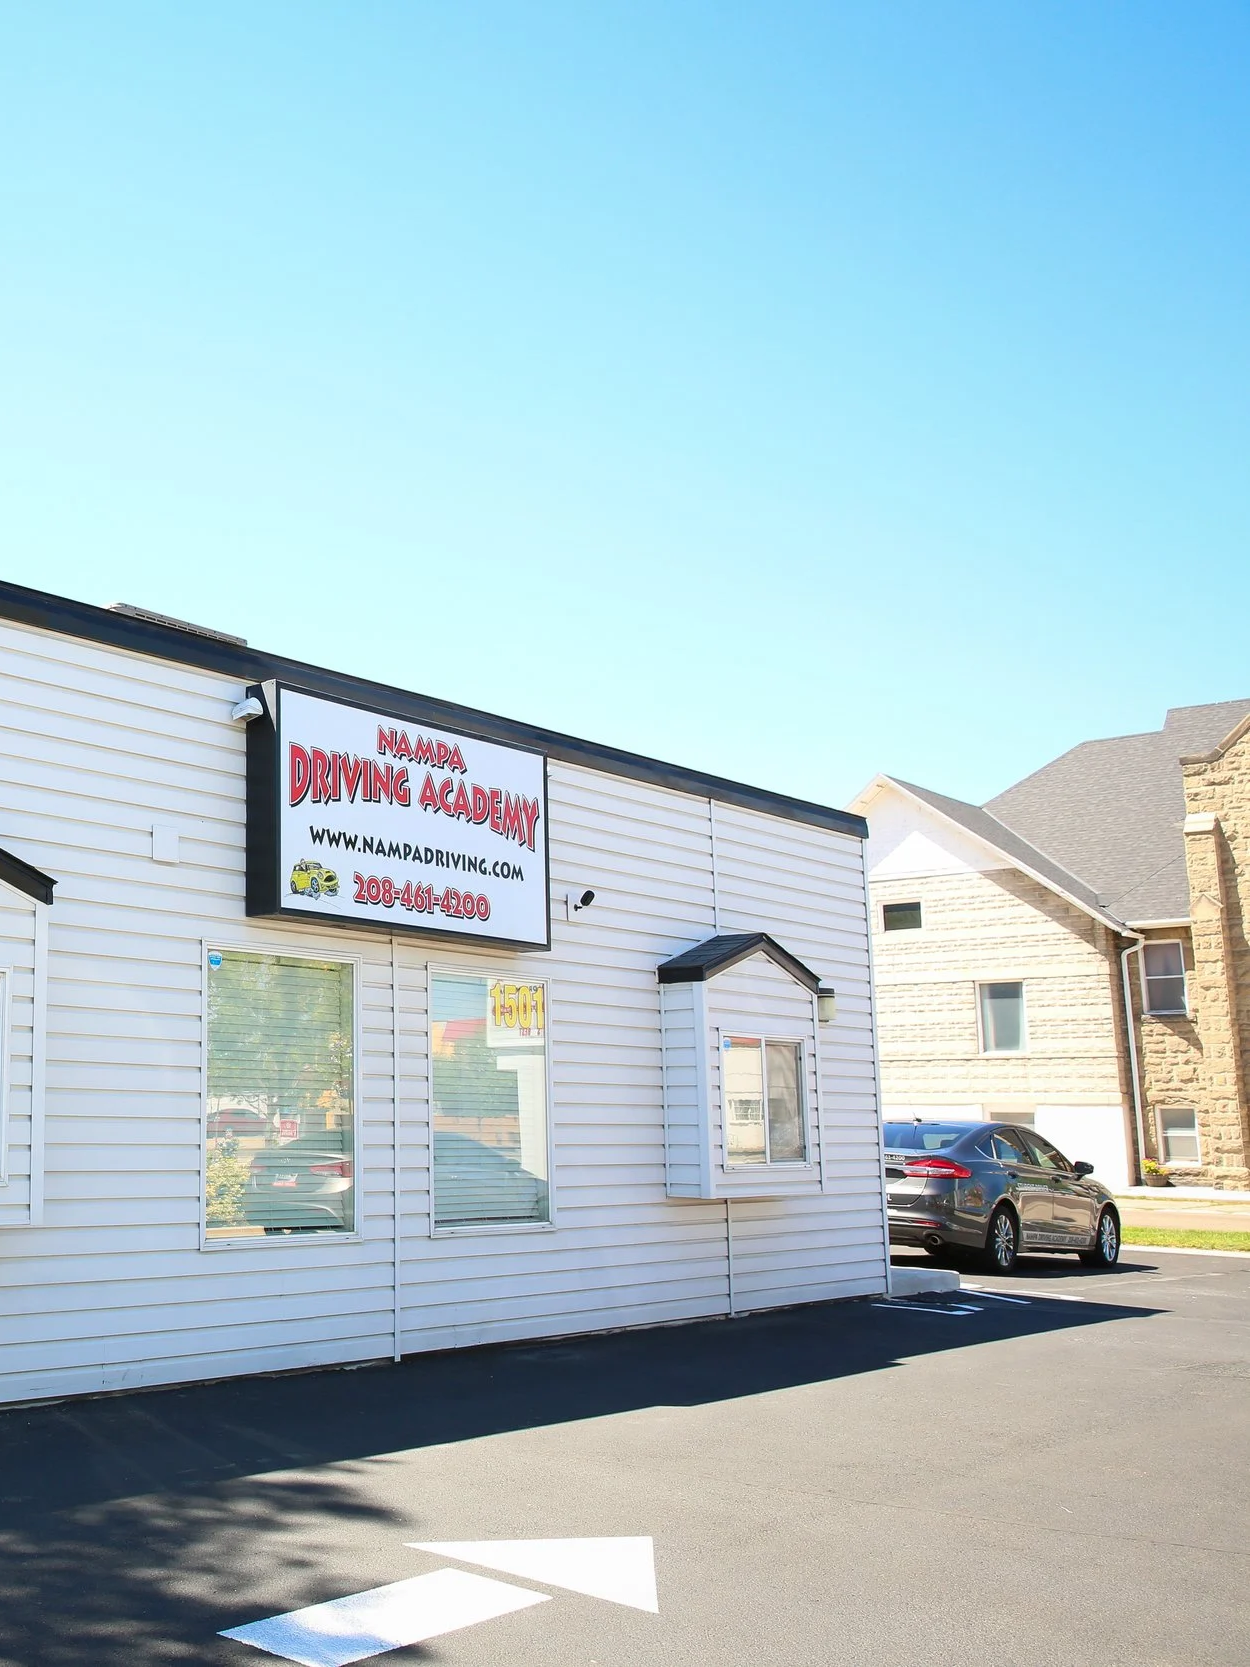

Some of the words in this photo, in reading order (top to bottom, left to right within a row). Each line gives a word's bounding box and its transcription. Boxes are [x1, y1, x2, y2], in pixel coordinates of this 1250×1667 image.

[376, 724, 468, 774] NAMPA
[288, 741, 411, 807] DRIVING
[418, 771, 540, 852] ACADEMY
[309, 825, 524, 881] WWW.NAMPADRIVING.COM
[353, 871, 491, 921] 208-461-4200
[490, 983, 544, 1029] 1501
